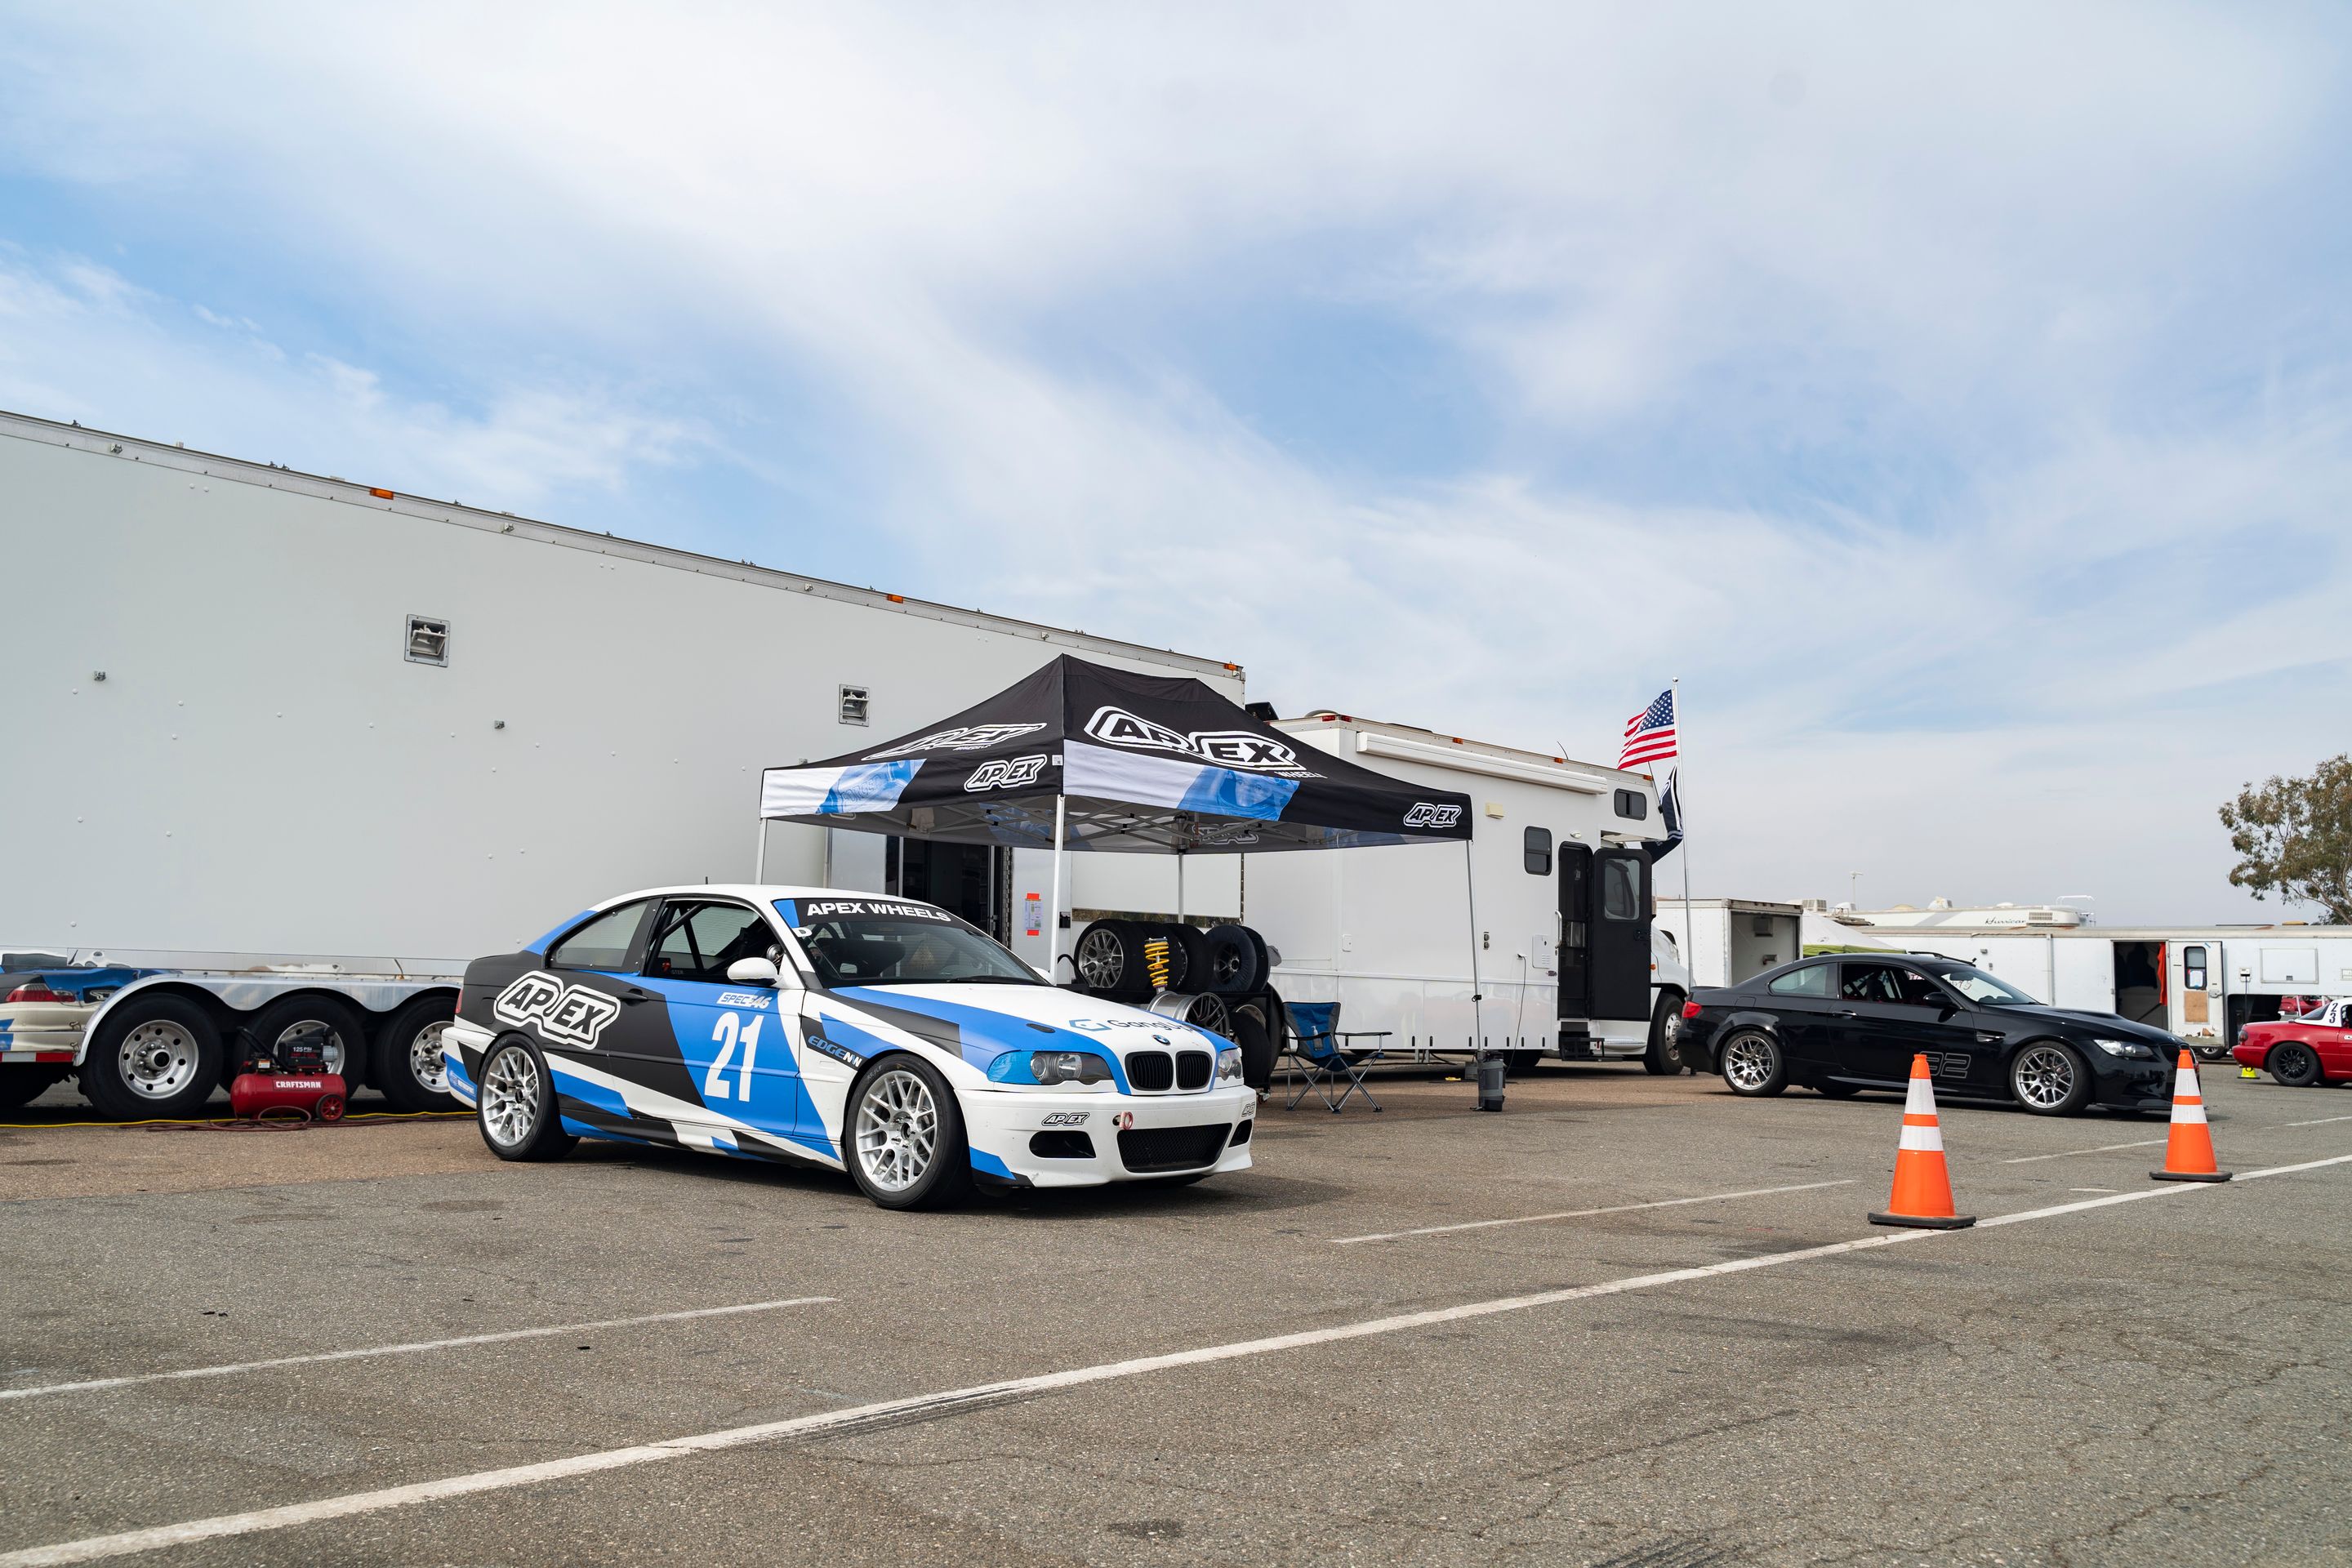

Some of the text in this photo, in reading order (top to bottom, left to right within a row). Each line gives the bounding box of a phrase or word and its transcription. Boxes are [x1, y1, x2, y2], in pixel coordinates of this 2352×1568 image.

[1098, 711, 1295, 766] APEX
[968, 758, 1042, 787] APEX
[1406, 805, 1459, 825] APEX
[807, 902, 951, 922] APEX WHEELS
[720, 994, 750, 1004] SPEC
[499, 977, 614, 1043] APEX
[704, 1011, 765, 1102] 21
[275, 1080, 322, 1089] CRAFTSMAN
[1043, 1113, 1089, 1125] APEX
